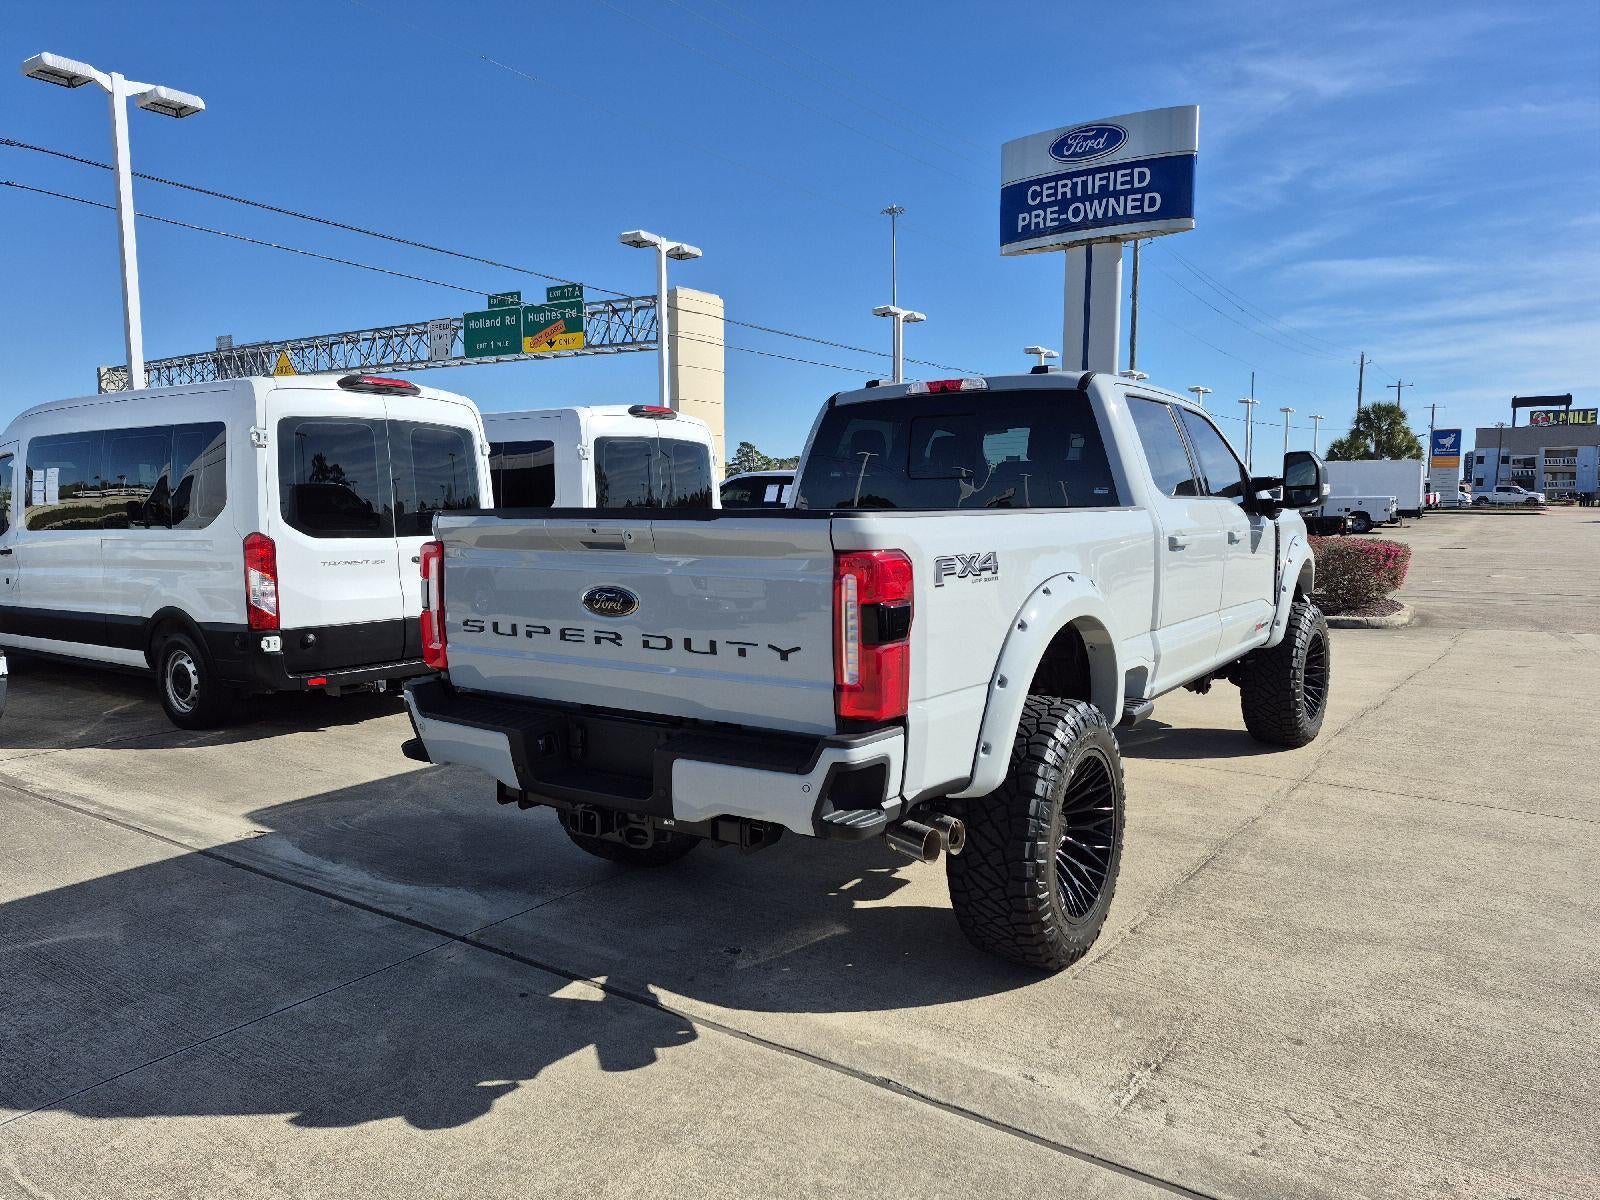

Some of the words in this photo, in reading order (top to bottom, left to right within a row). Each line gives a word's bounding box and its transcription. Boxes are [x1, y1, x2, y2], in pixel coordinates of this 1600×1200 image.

[1063, 129, 1109, 156] Ford
[1027, 167, 1150, 206] CERTIFIED
[1017, 192, 1162, 233] PRE-OWNED
[550, 289, 561, 298] EXIT
[564, 287, 573, 297] 17
[574, 286, 581, 297] A
[469, 317, 501, 330] Holland
[505, 315, 516, 326] Rd
[528, 310, 561, 323] Hughes
[565, 307, 577, 318] Rd
[431, 323, 450, 332] SPEED
[476, 342, 488, 350] EXIT
[490, 341, 495, 349] 1
[558, 338, 577, 346] ONLY
[1559, 410, 1597, 424] MILE
[320, 559, 370, 567] TRANSIT
[933, 552, 999, 588] FX4
[593, 591, 623, 611] Ford
[462, 618, 623, 647] SUPER
[641, 633, 802, 662] DUTY
